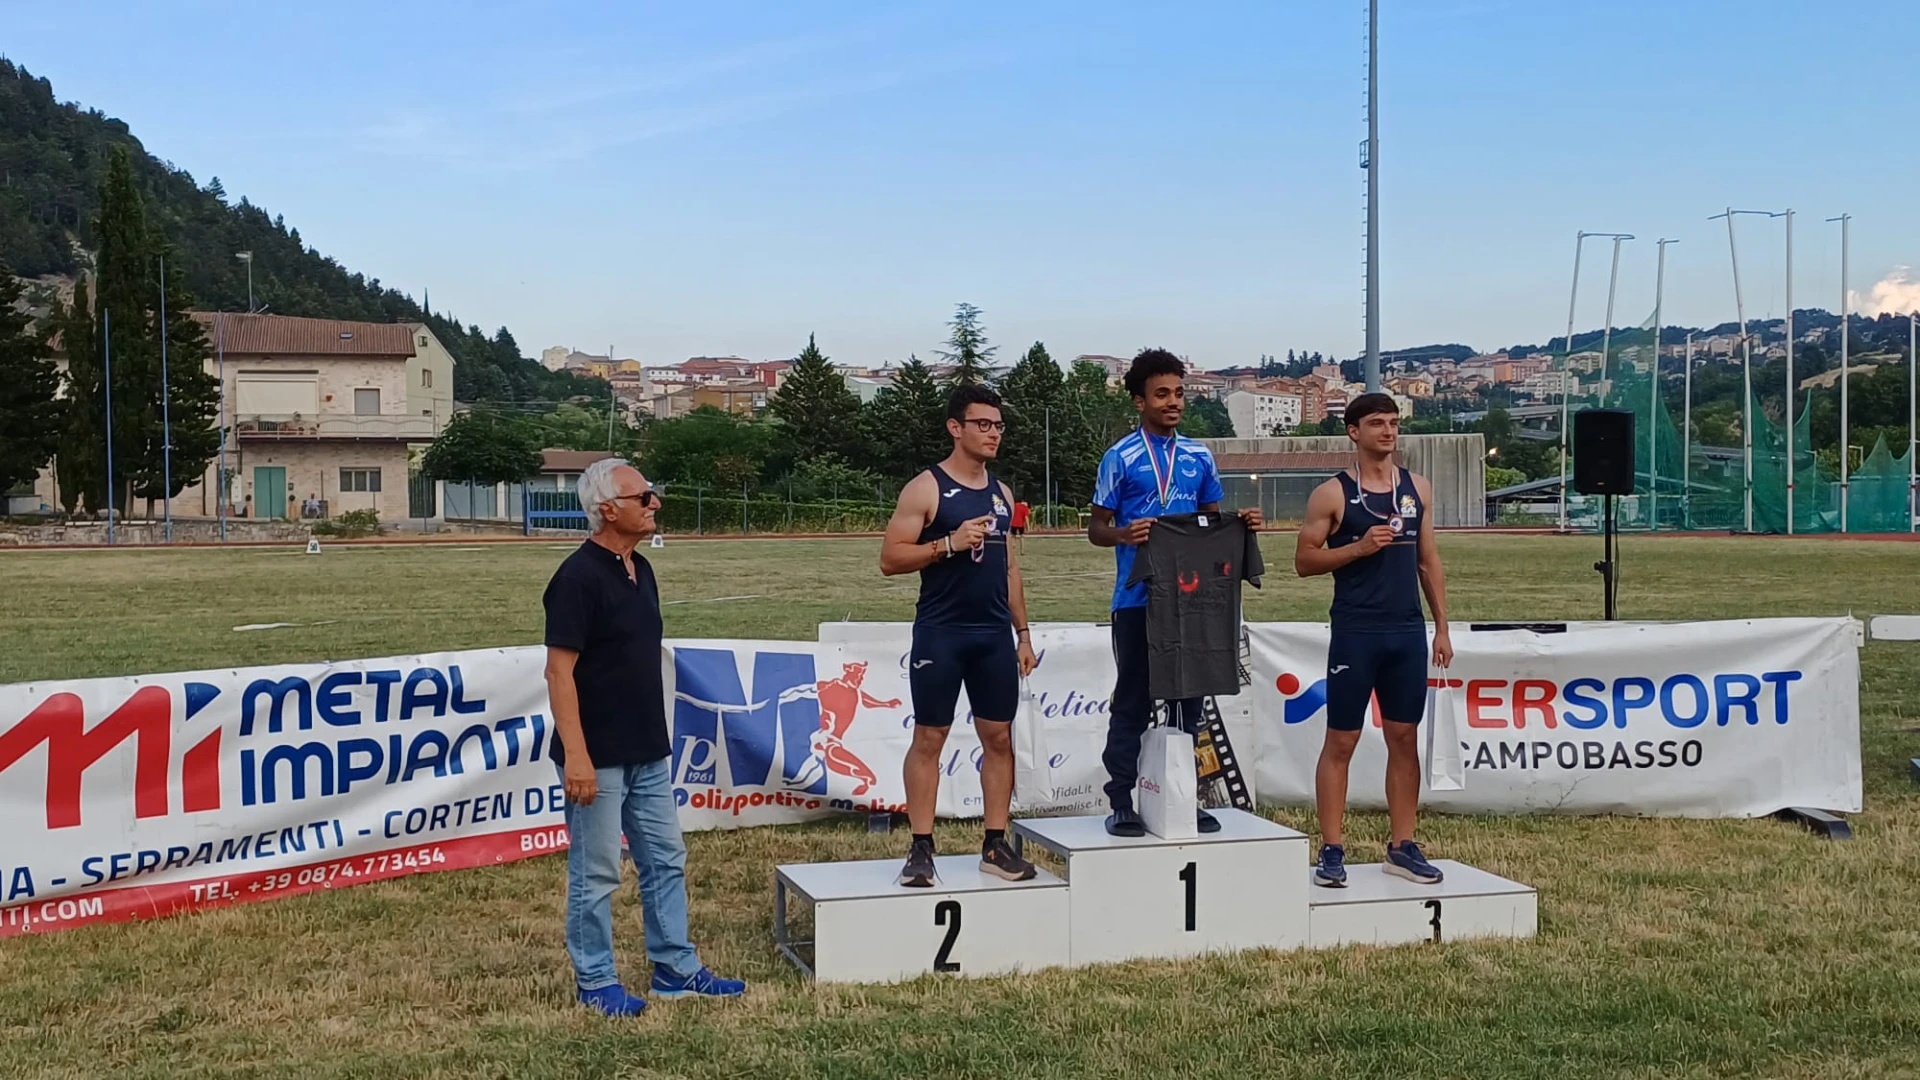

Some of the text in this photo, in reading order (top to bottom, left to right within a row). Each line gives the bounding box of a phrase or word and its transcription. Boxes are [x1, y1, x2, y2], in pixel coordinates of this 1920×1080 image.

[239, 666, 486, 736] METAL
[239, 714, 544, 806] IMPIANTI
[687, 772, 712, 783] 1961
[81, 819, 343, 888] SERRAMENTI
[384, 791, 512, 839] CORTEN
[190, 881, 239, 902] TEL.
[248, 873, 291, 893] +39
[297, 847, 446, 885] 0874.773454
[1179, 862, 1196, 931] 1
[934, 900, 962, 972] 2
[1424, 900, 1442, 944] 3
